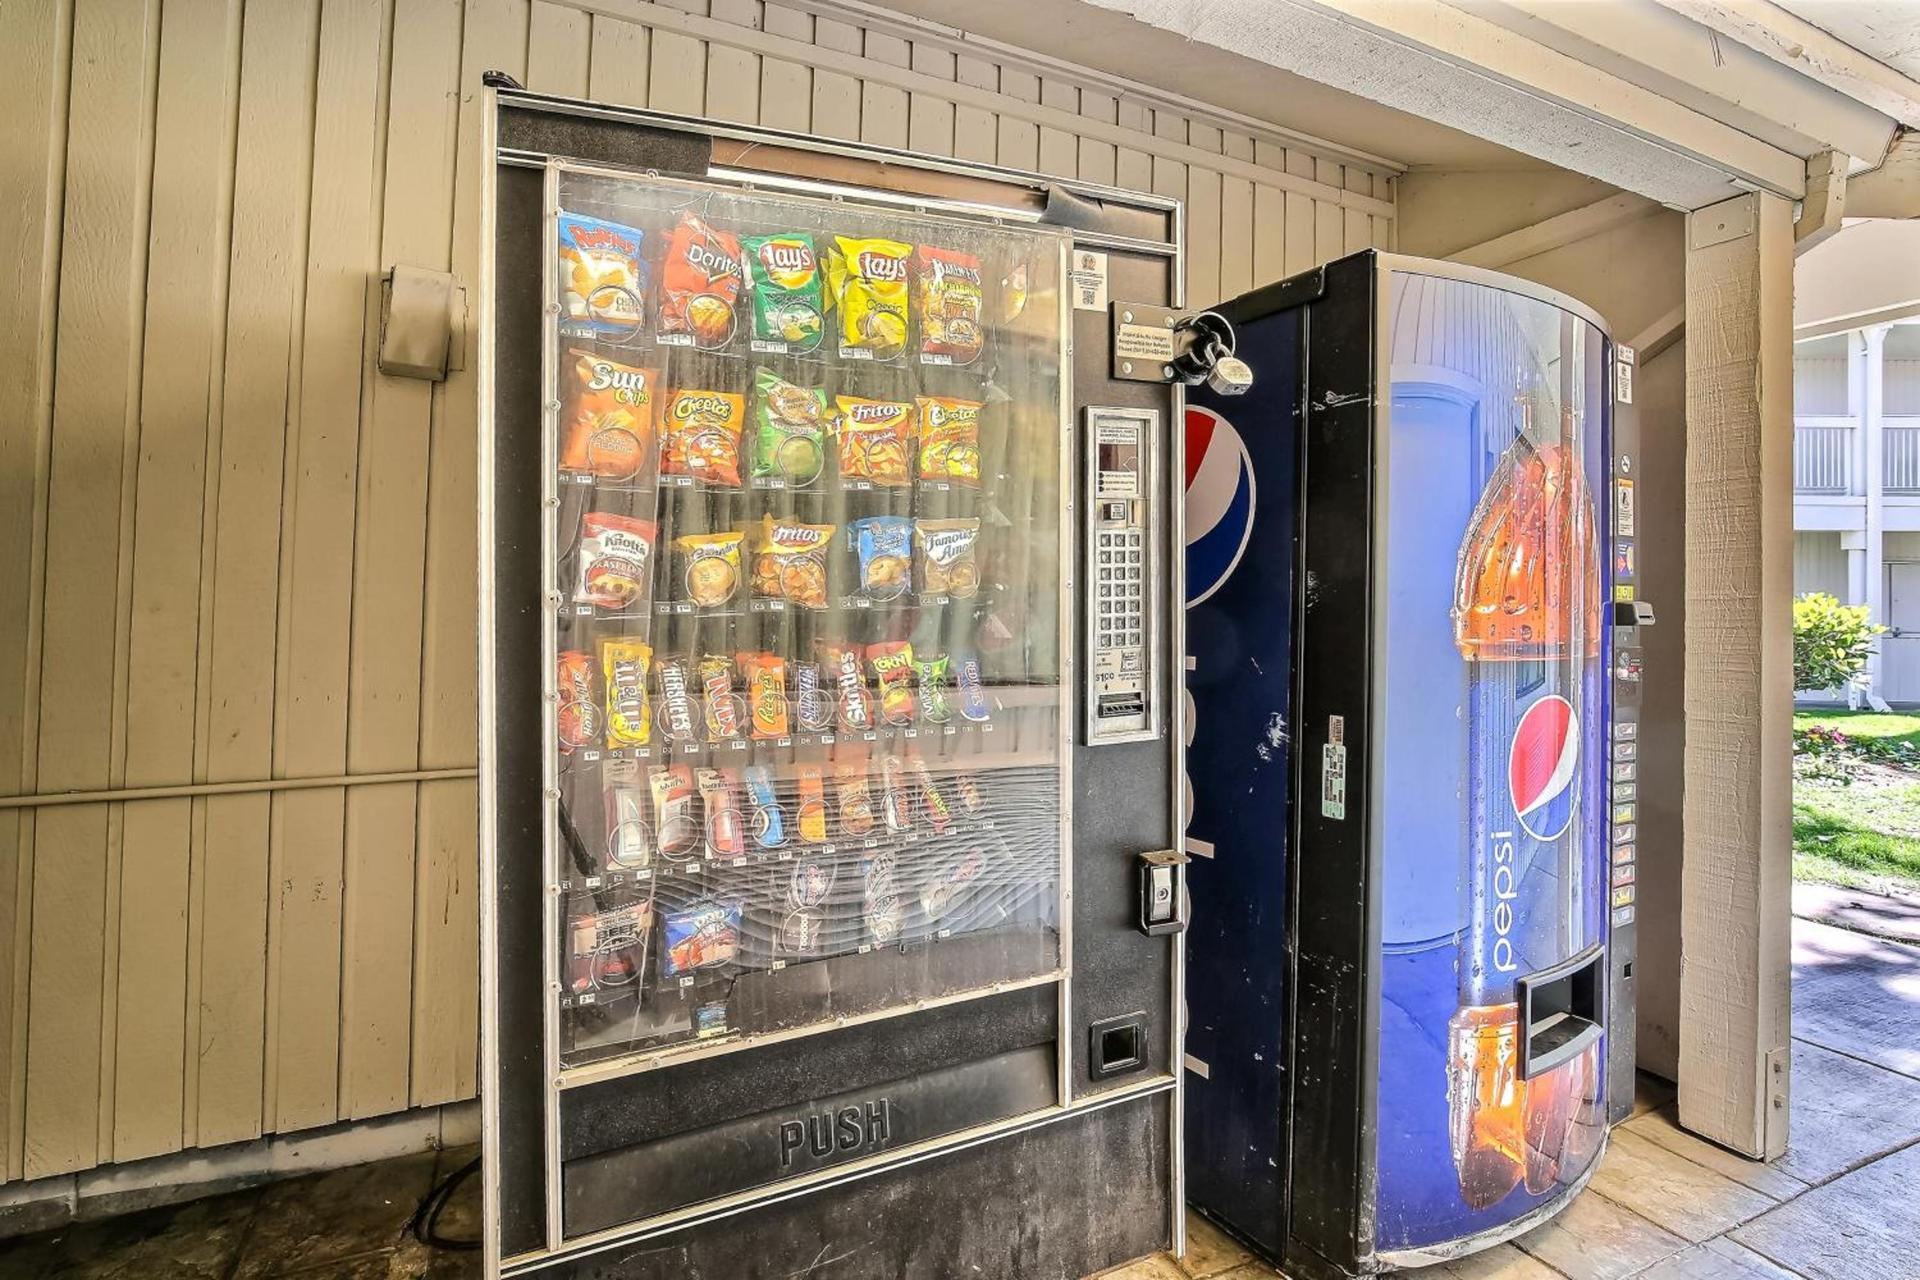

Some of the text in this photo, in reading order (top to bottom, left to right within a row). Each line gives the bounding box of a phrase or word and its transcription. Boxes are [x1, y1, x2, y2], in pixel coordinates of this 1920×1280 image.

[688, 244, 742, 279] Doritos
[588, 363, 646, 391] Sun
[614, 389, 650, 407] Chips
[674, 397, 732, 420] Cheetos
[851, 404, 902, 422] Fritos
[925, 528, 973, 553] Famous
[937, 543, 971, 562] Amo
[798, 665, 818, 723] SNICKERS
[1491, 831, 1518, 973] pepsi
[596, 922, 639, 941] BEEF
[779, 1098, 891, 1167] PUSH
